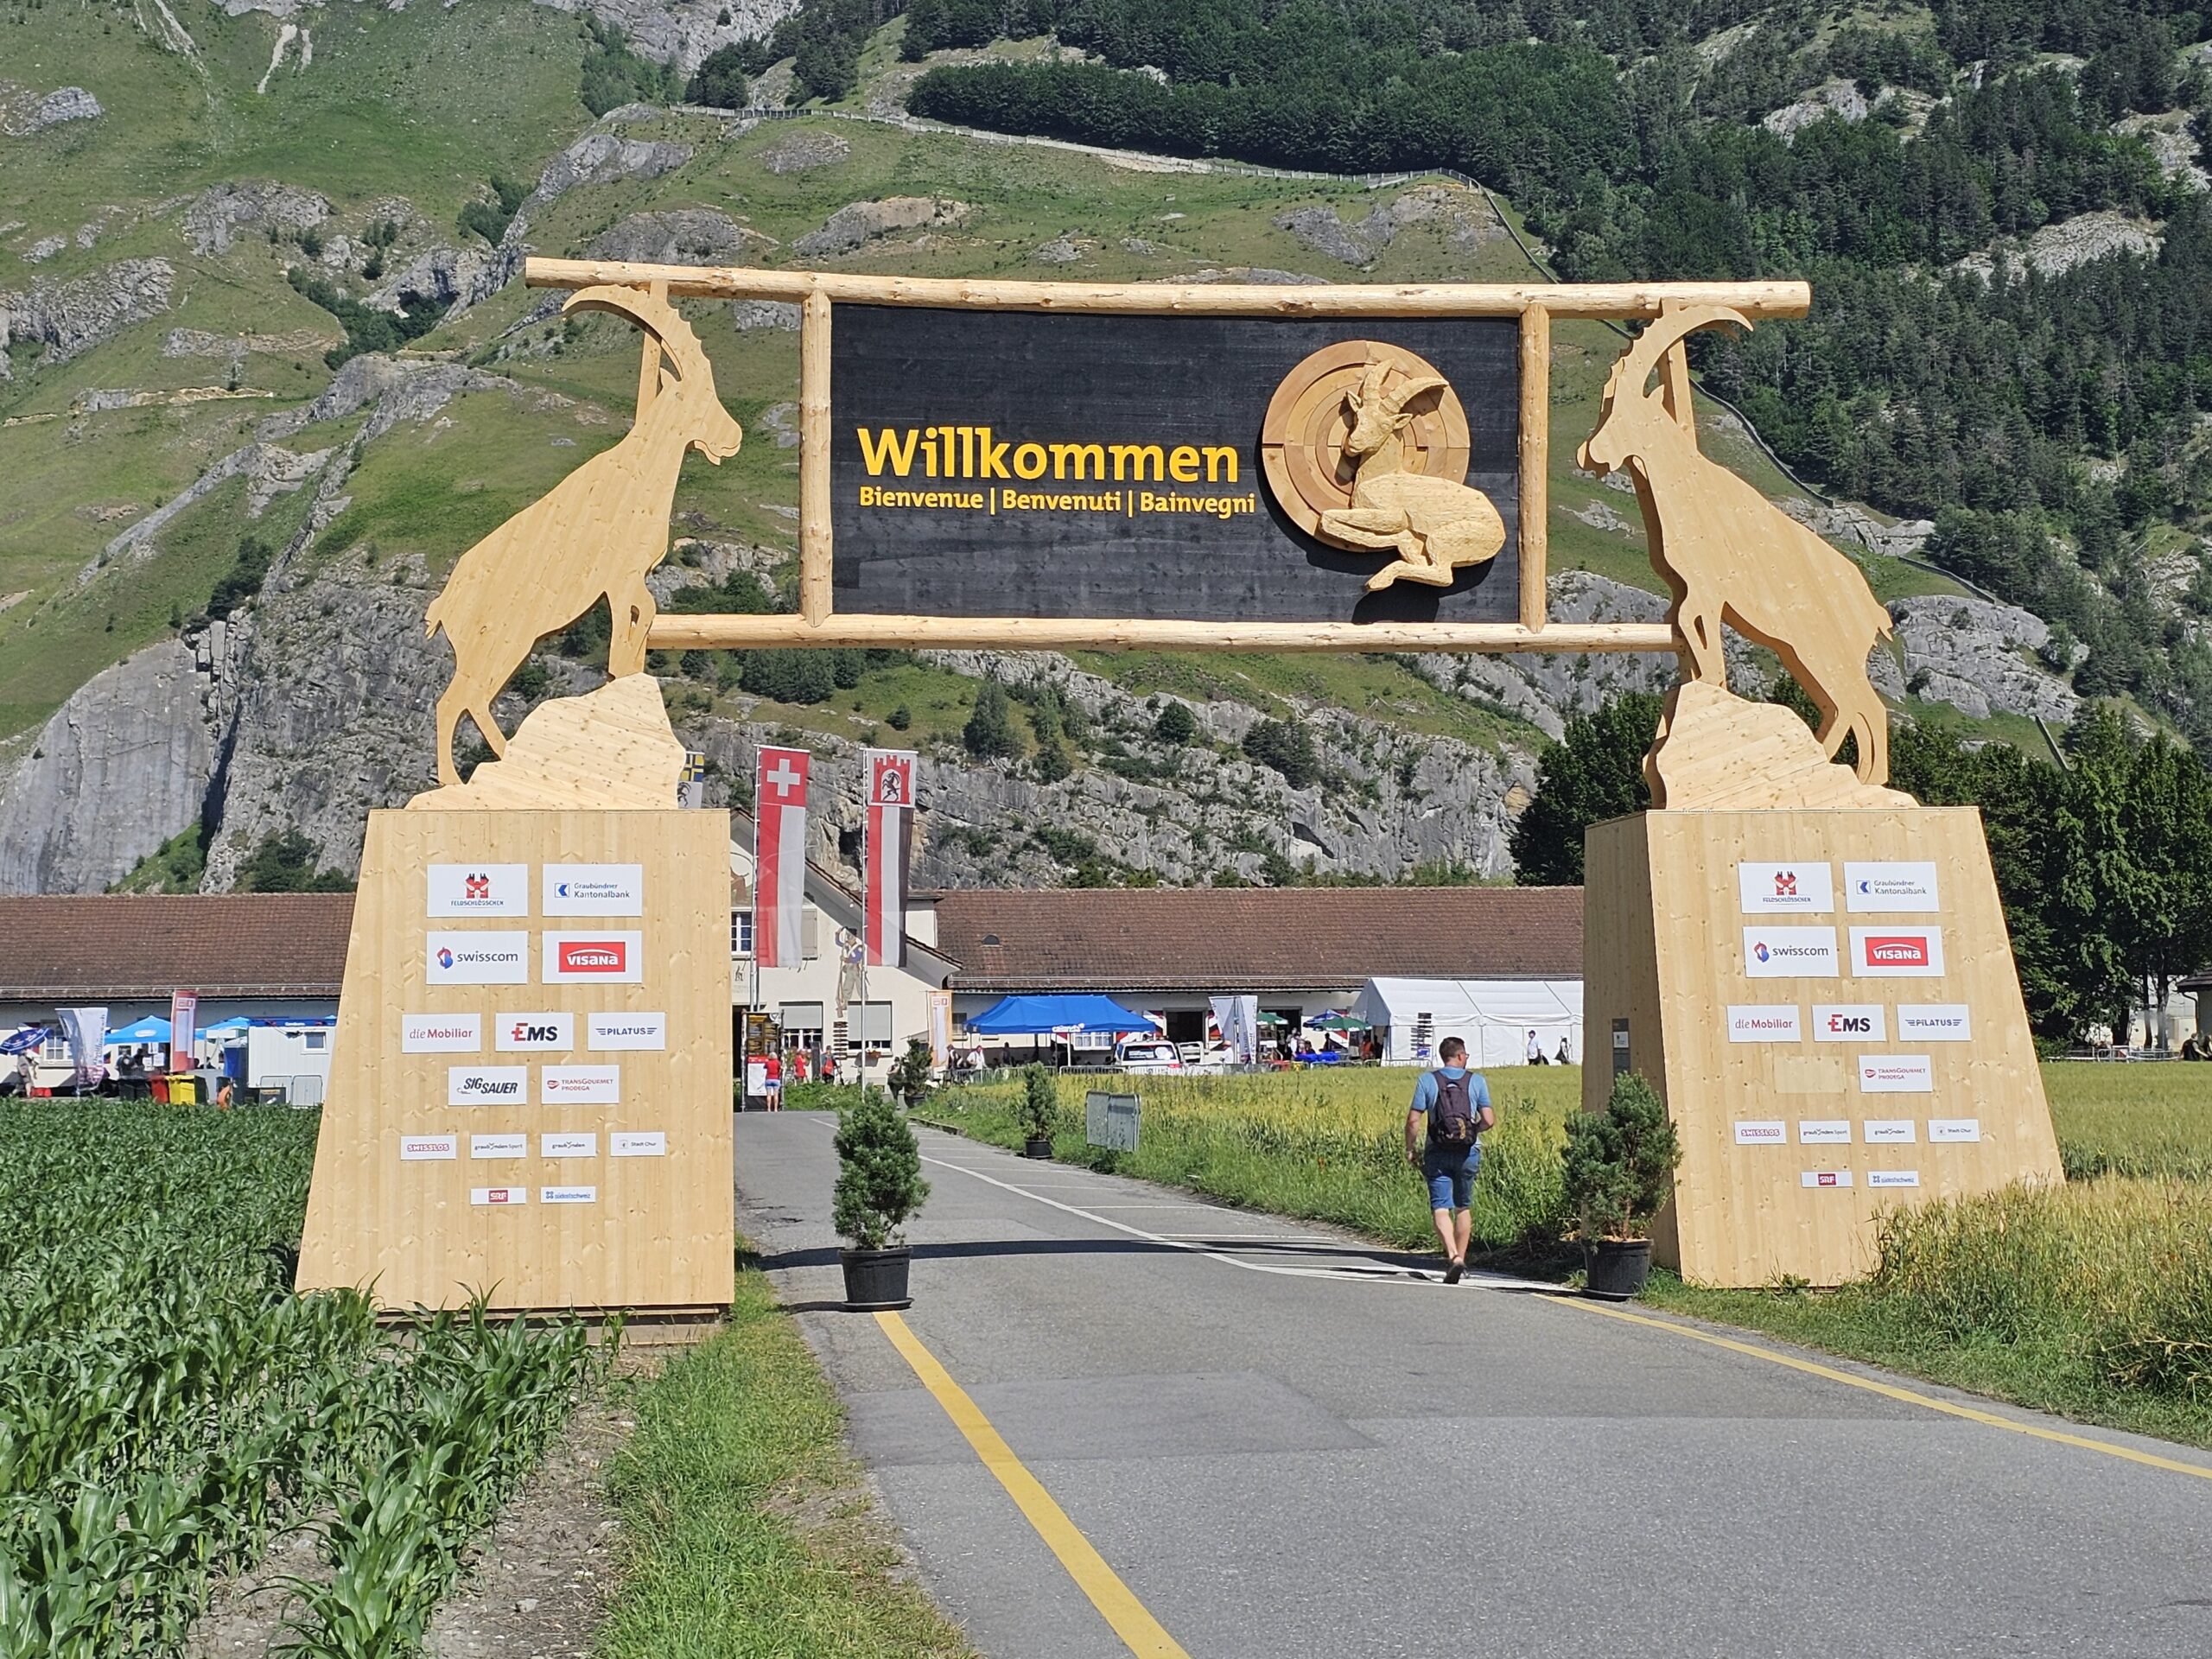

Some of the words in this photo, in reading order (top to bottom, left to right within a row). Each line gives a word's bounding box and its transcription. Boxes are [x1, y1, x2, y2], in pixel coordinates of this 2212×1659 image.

[856, 426, 1238, 483] Willkommen
[859, 486, 984, 510] Bienvenue
[1001, 489, 1122, 512] Benvenuti
[1139, 491, 1256, 519] Bainvegni
[574, 891, 631, 899] Kantonalbank
[1874, 887, 1928, 895] Kantonalbank
[456, 950, 519, 963] swisscom
[1772, 944, 1829, 957] swisscom
[1751, 1018, 1794, 1030] Mobiliar
[1827, 1014, 1871, 1033] EMS
[427, 1027, 474, 1039] Mobiliar
[511, 1022, 558, 1042] EMS
[607, 1027, 647, 1036] PILATUS
[463, 1077, 484, 1090] SIG
[480, 1082, 518, 1095] SAUER
[1740, 1128, 1781, 1137] SWISSLOS
[407, 1143, 450, 1153] SWISSLOS
[1819, 1175, 1835, 1184] SRF
[490, 1192, 507, 1201] SRF
